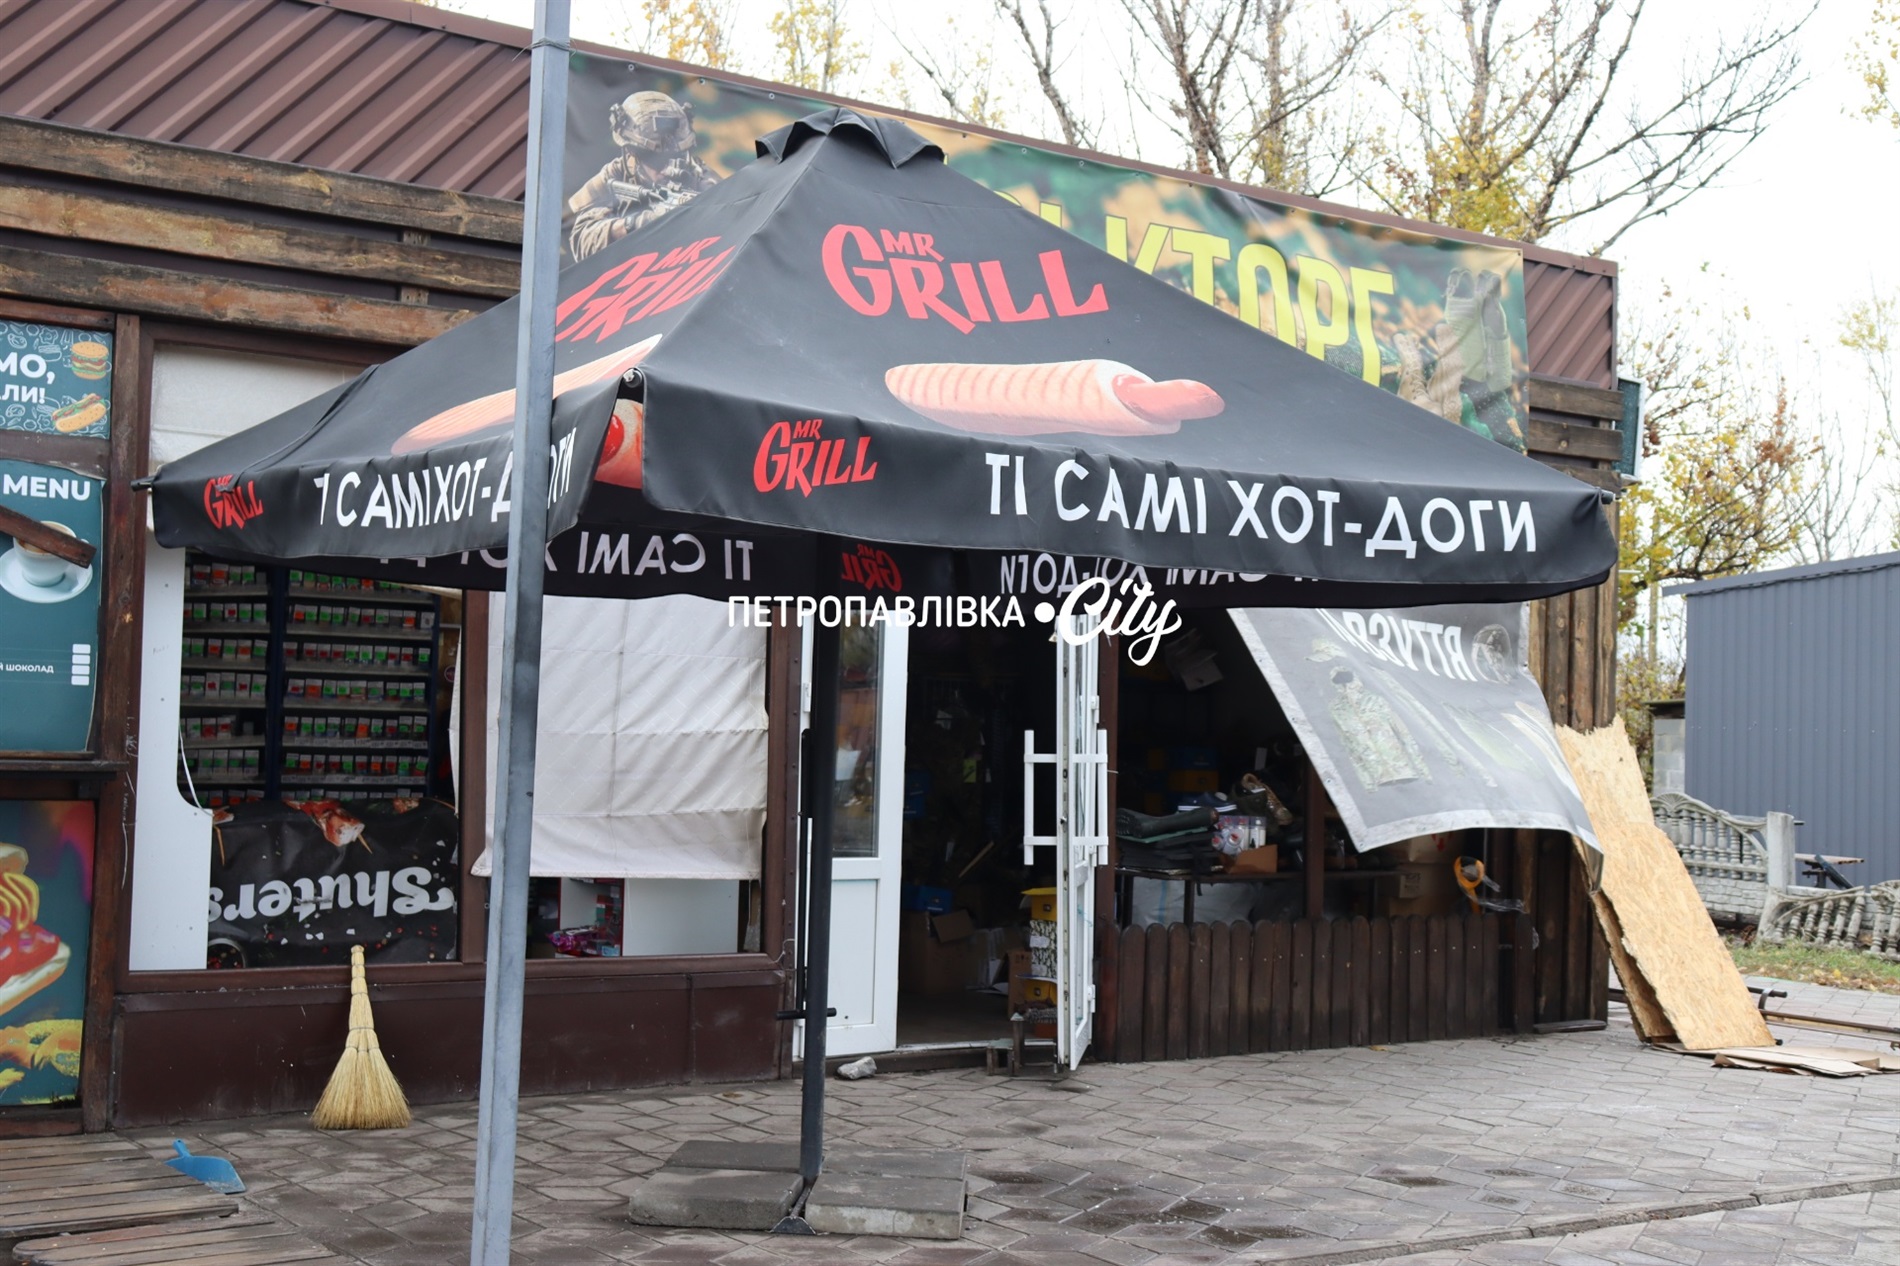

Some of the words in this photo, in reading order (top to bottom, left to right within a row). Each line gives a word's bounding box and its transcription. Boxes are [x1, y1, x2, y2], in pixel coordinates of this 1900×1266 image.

[649, 236, 722, 272] MR
[880, 229, 945, 262] MR
[821, 224, 1109, 334] GRILL
[0, 383, 46, 404] ЛИ!
[793, 418, 822, 440] MR
[753, 421, 878, 498] GRILL
[3, 473, 91, 501] MENU
[335, 469, 431, 529] САМІ
[985, 452, 1028, 516] ТІ
[1054, 459, 1208, 535] САМІ
[1229, 480, 1537, 559] ХОТ-ДОГИ
[5, 663, 54, 675] ШОКОЛАД
